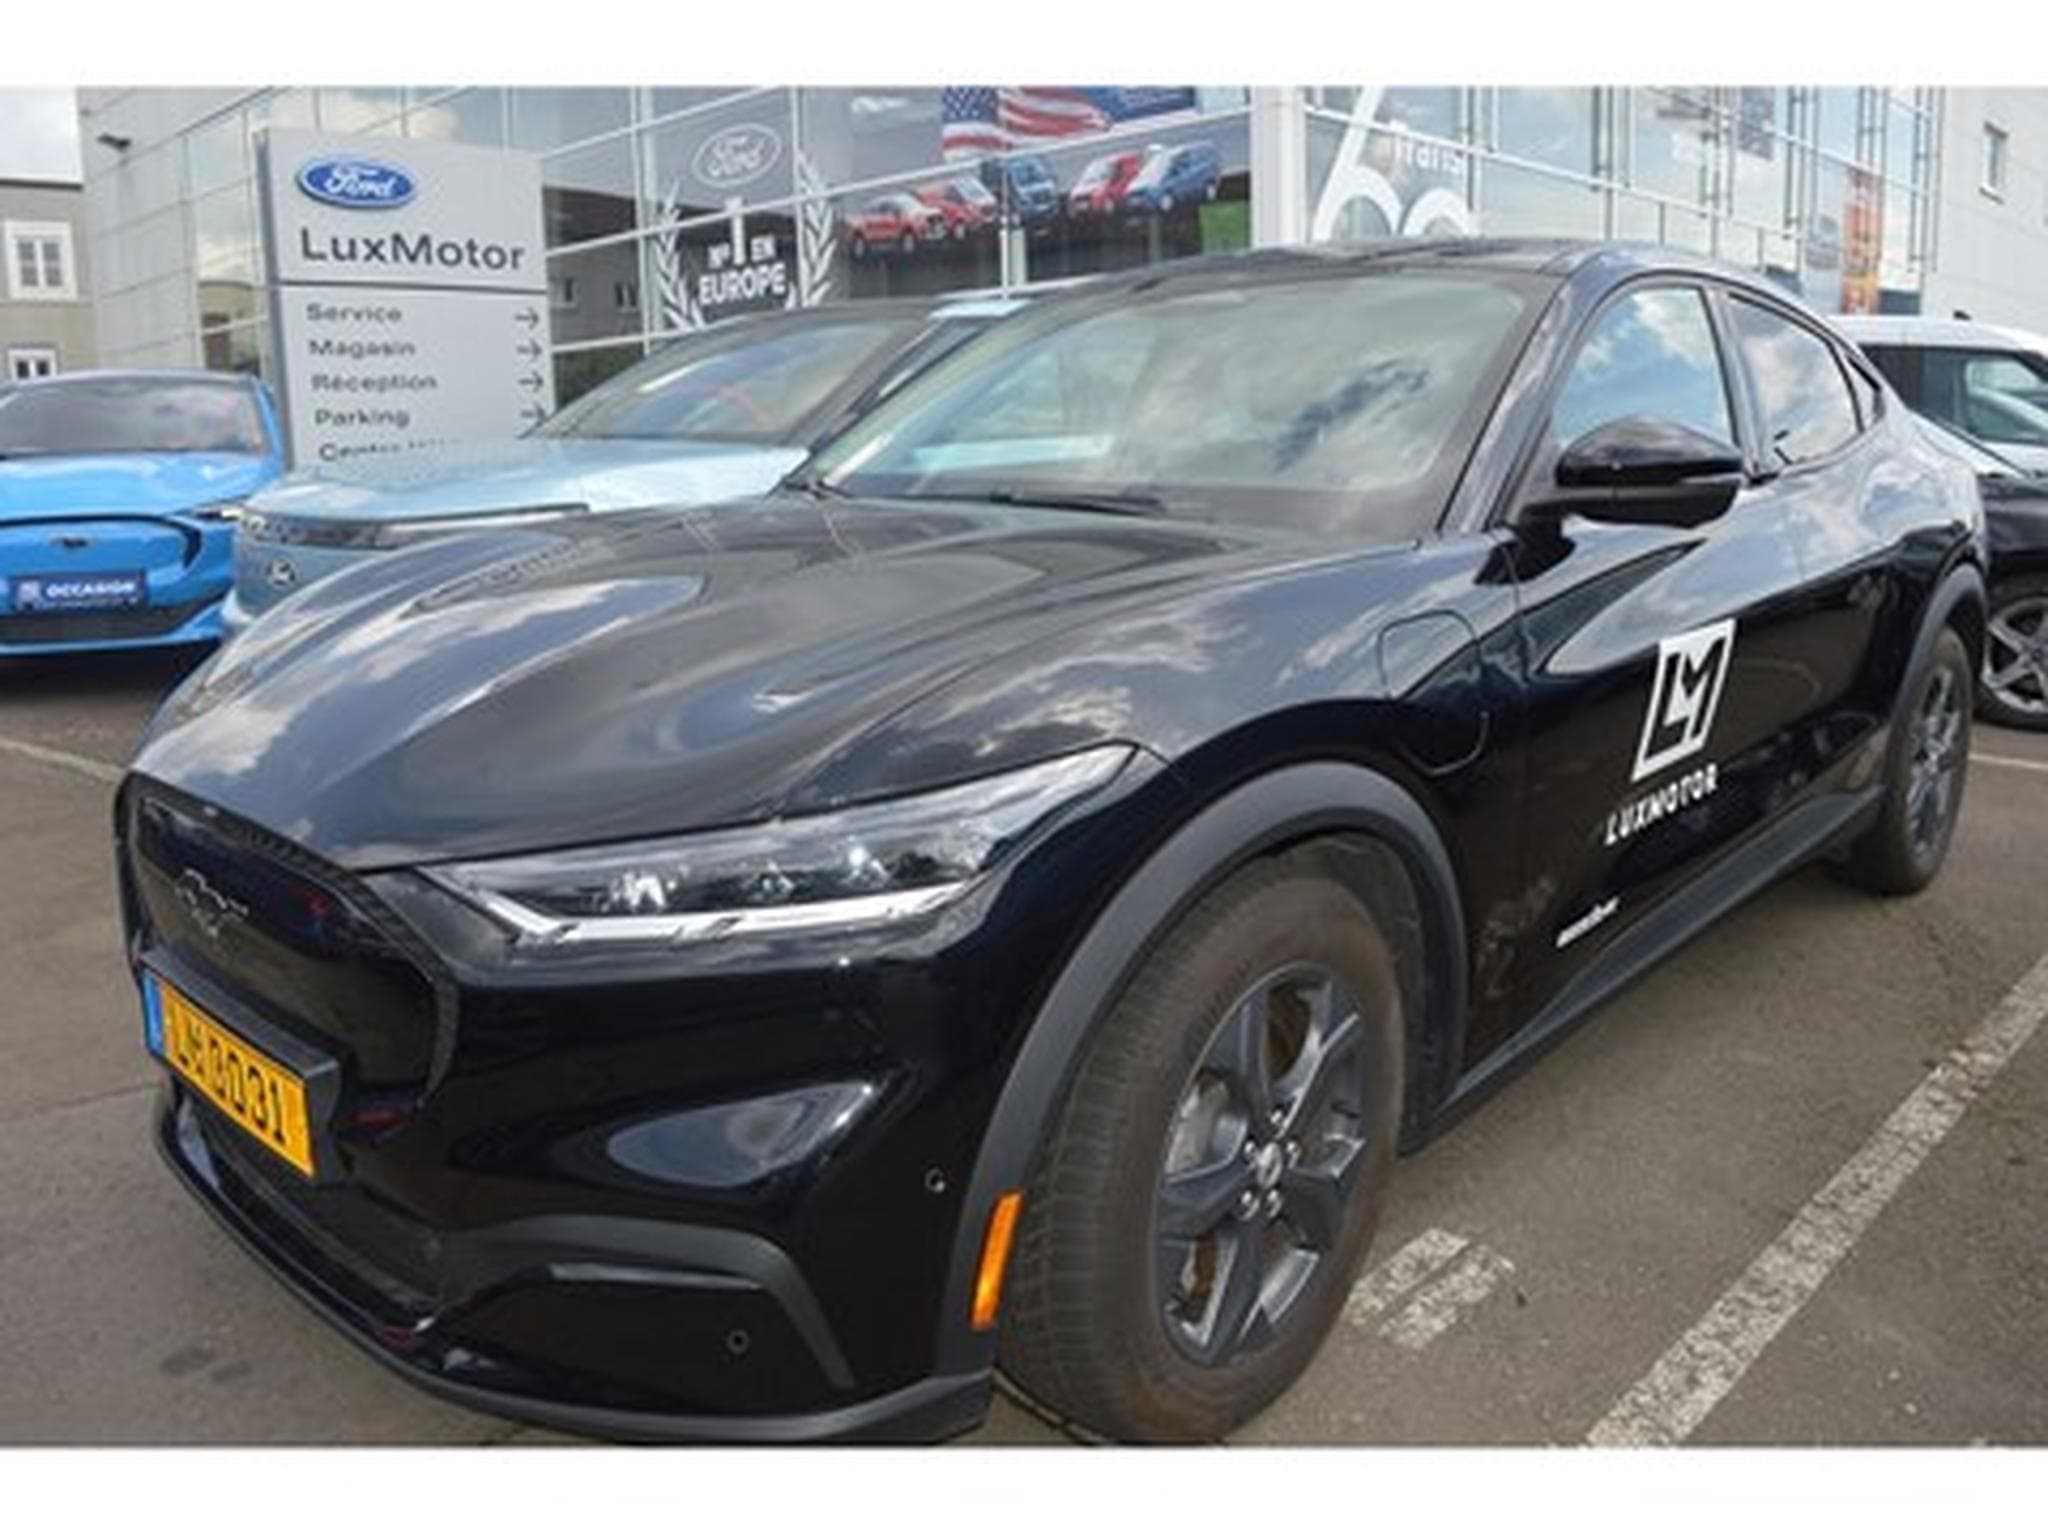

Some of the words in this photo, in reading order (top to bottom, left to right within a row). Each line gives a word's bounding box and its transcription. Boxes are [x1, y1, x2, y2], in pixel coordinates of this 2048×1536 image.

[323, 160, 398, 198] Ford
[300, 226, 525, 270] LuxMotor
[700, 261, 786, 306] EUROPE
[306, 303, 402, 323] Service
[309, 339, 416, 360] Magasin
[314, 408, 411, 430] Parking
